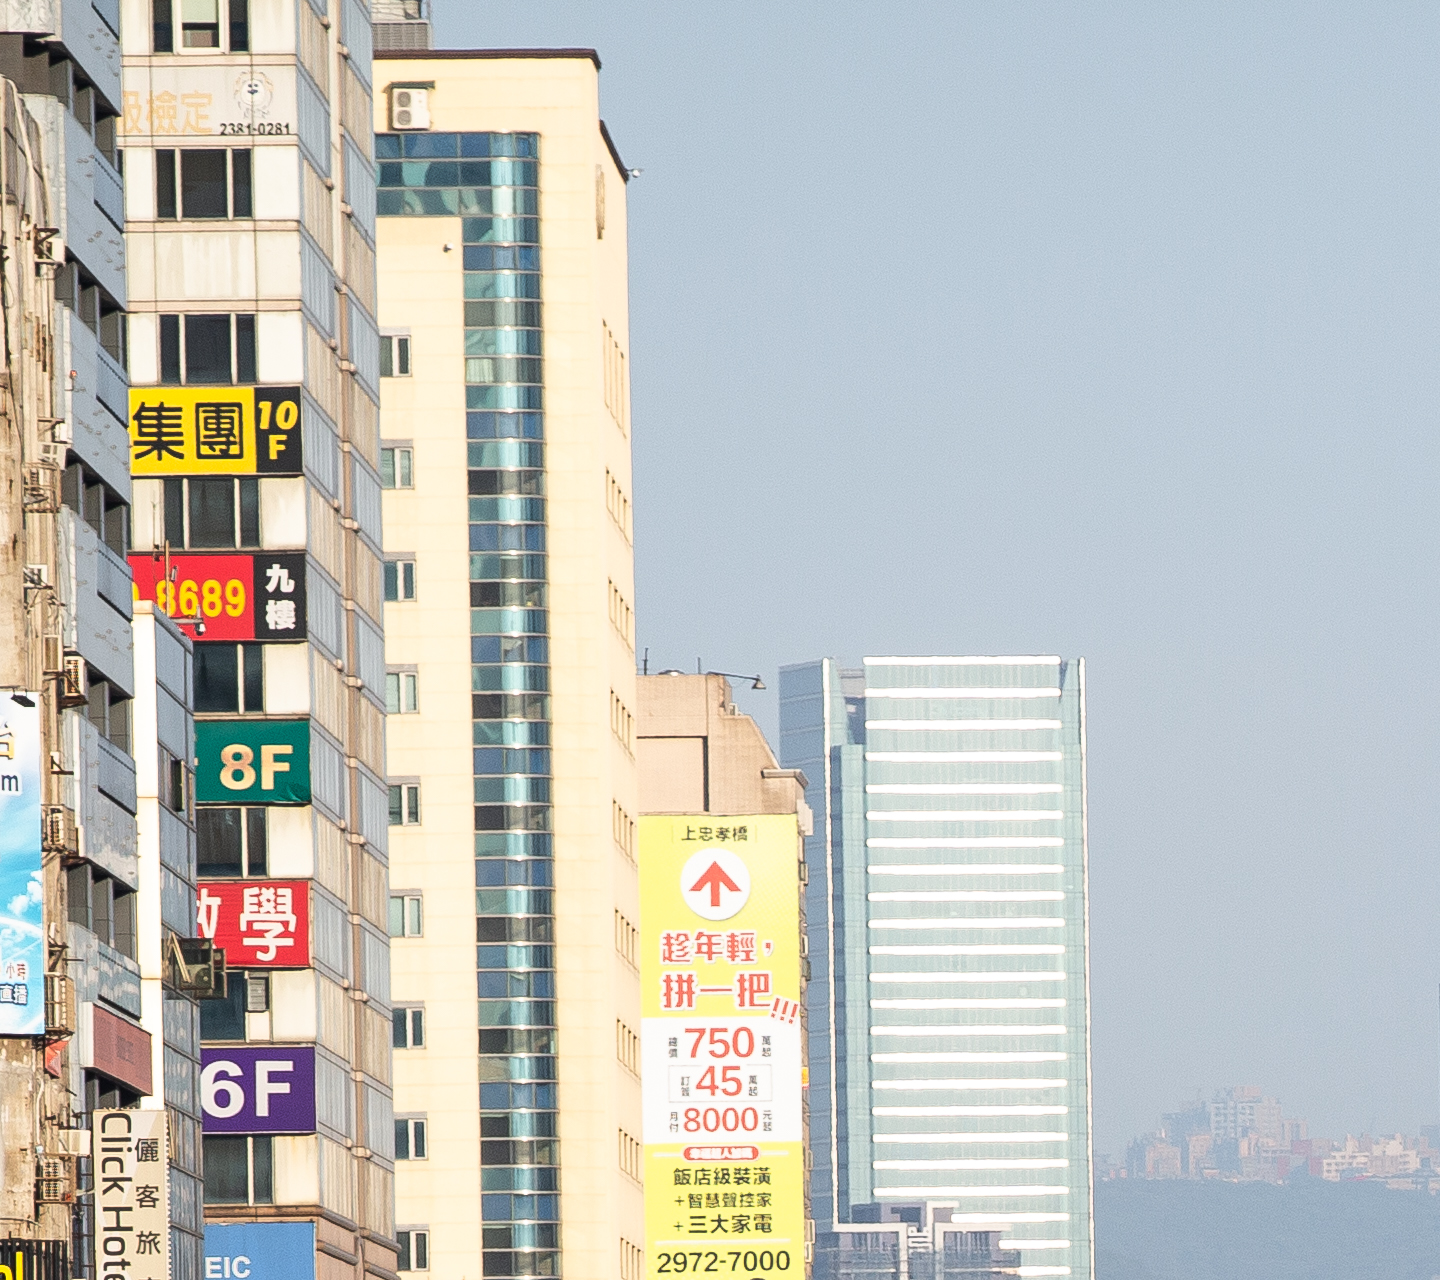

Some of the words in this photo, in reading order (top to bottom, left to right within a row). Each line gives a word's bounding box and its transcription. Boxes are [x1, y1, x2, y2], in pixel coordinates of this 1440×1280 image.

[219, 121, 291, 137] 2381-0281
[258, 400, 299, 430] 10
[132, 401, 244, 461] 集團
[268, 434, 288, 460] F
[265, 563, 296, 630] 九樓
[219, 743, 294, 791] 8F
[681, 825, 748, 842] 上忠孝橋
[684, 1026, 755, 1059] 750
[200, 1060, 294, 1118] 6F
[696, 1065, 743, 1096] 45
[683, 1107, 759, 1132] 8000
[101, 1113, 133, 1196] Click
[673, 1167, 772, 1186] 飯店級裝潢
[657, 1250, 791, 1273] 2972-7000
